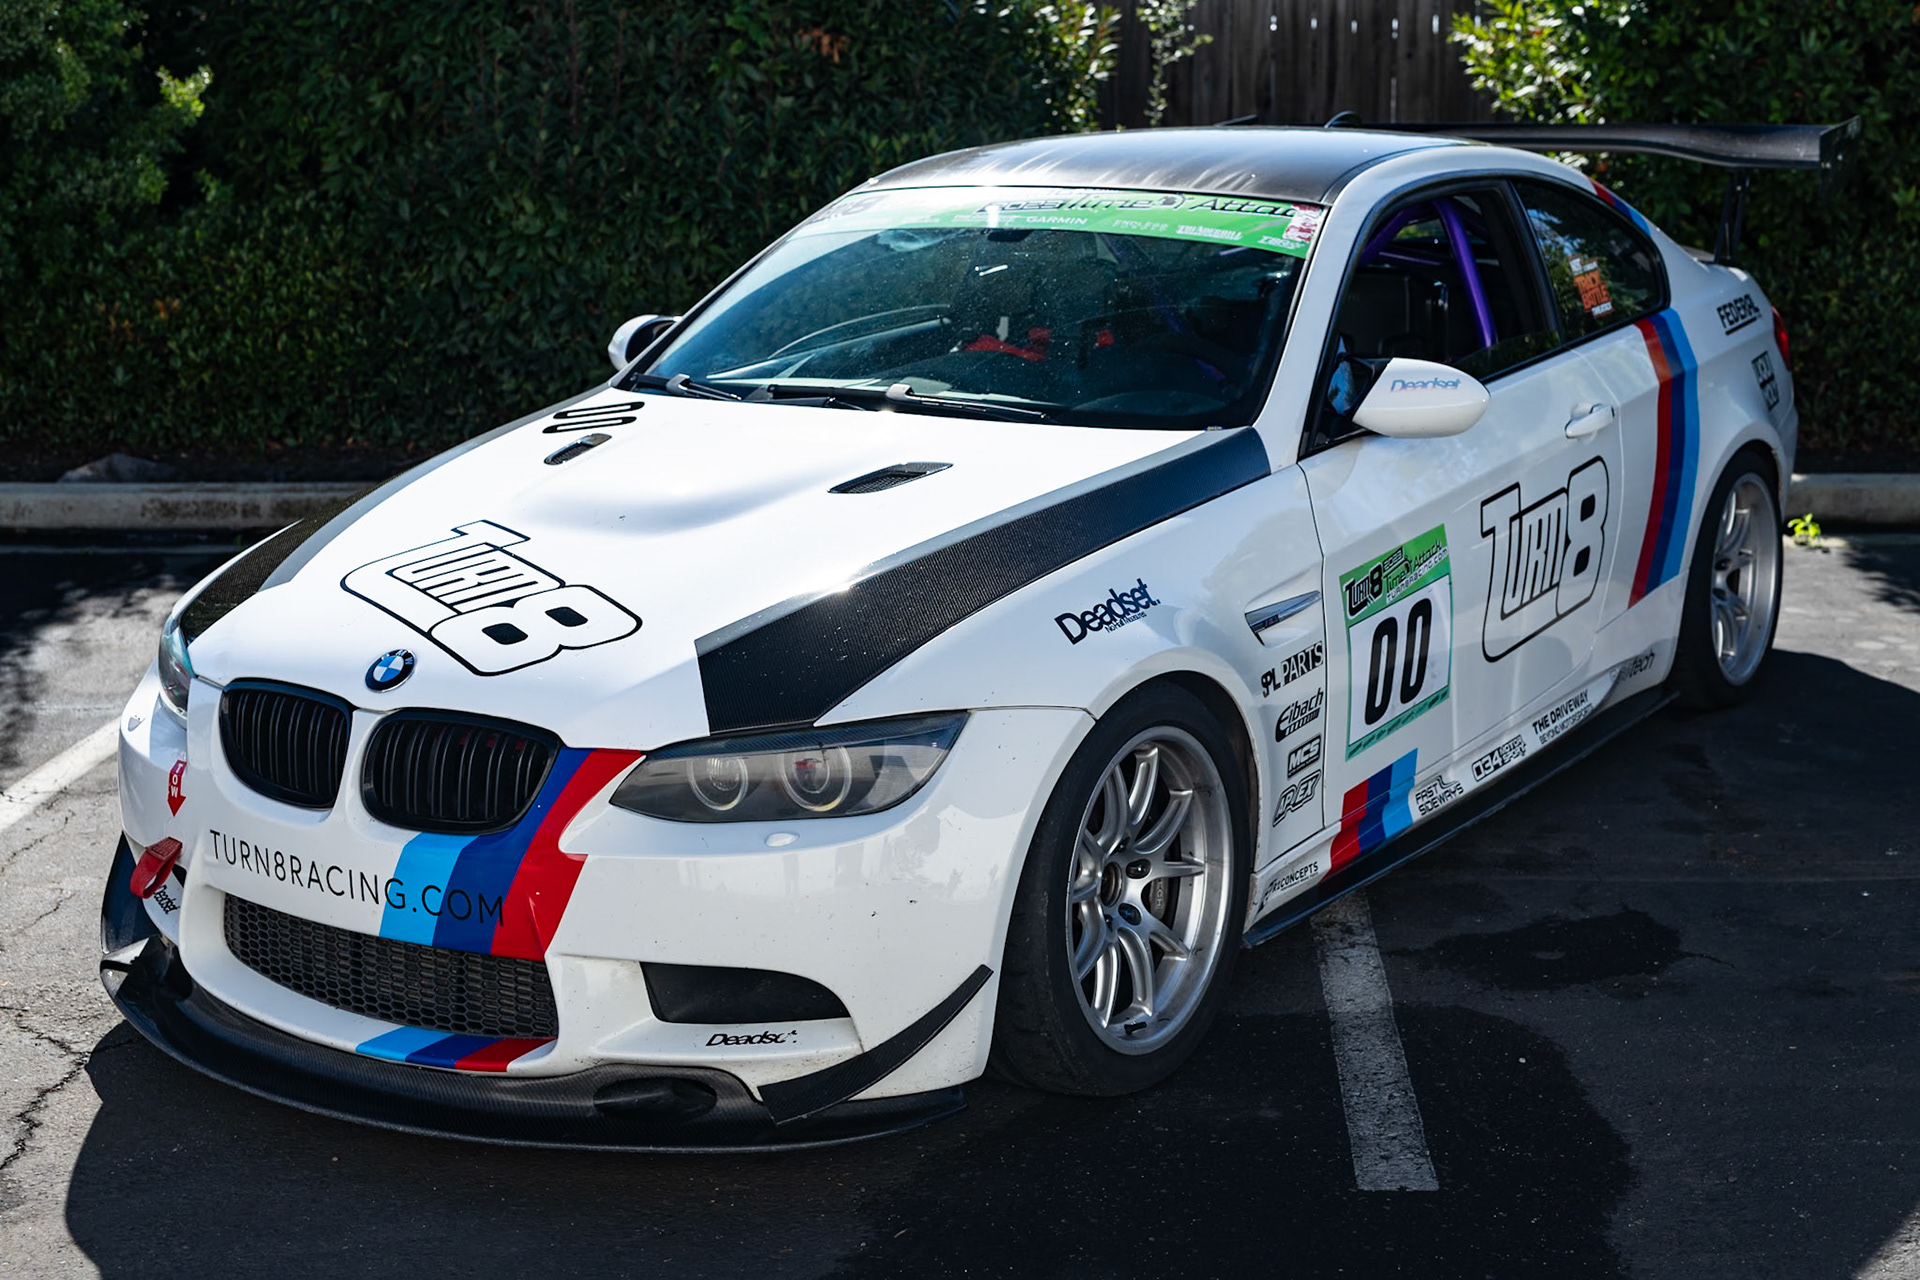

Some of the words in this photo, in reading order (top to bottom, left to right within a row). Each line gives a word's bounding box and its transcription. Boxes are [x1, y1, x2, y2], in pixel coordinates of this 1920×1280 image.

[1027, 216, 1088, 225] GARMIN
[1281, 642, 1323, 687] PARTS
[1364, 598, 1432, 725] 00
[1276, 688, 1323, 742] Eibach
[1532, 714, 1550, 735] THE
[1550, 689, 1588, 724] DRIVEWAY
[1288, 736, 1321, 771] MCS
[1472, 749, 1503, 782] 034
[170, 762, 184, 798] TOW
[1415, 782, 1438, 805] FAST
[1418, 783, 1464, 816] SIDEWAYS
[209, 829, 504, 927] TURN8RACING.COM
